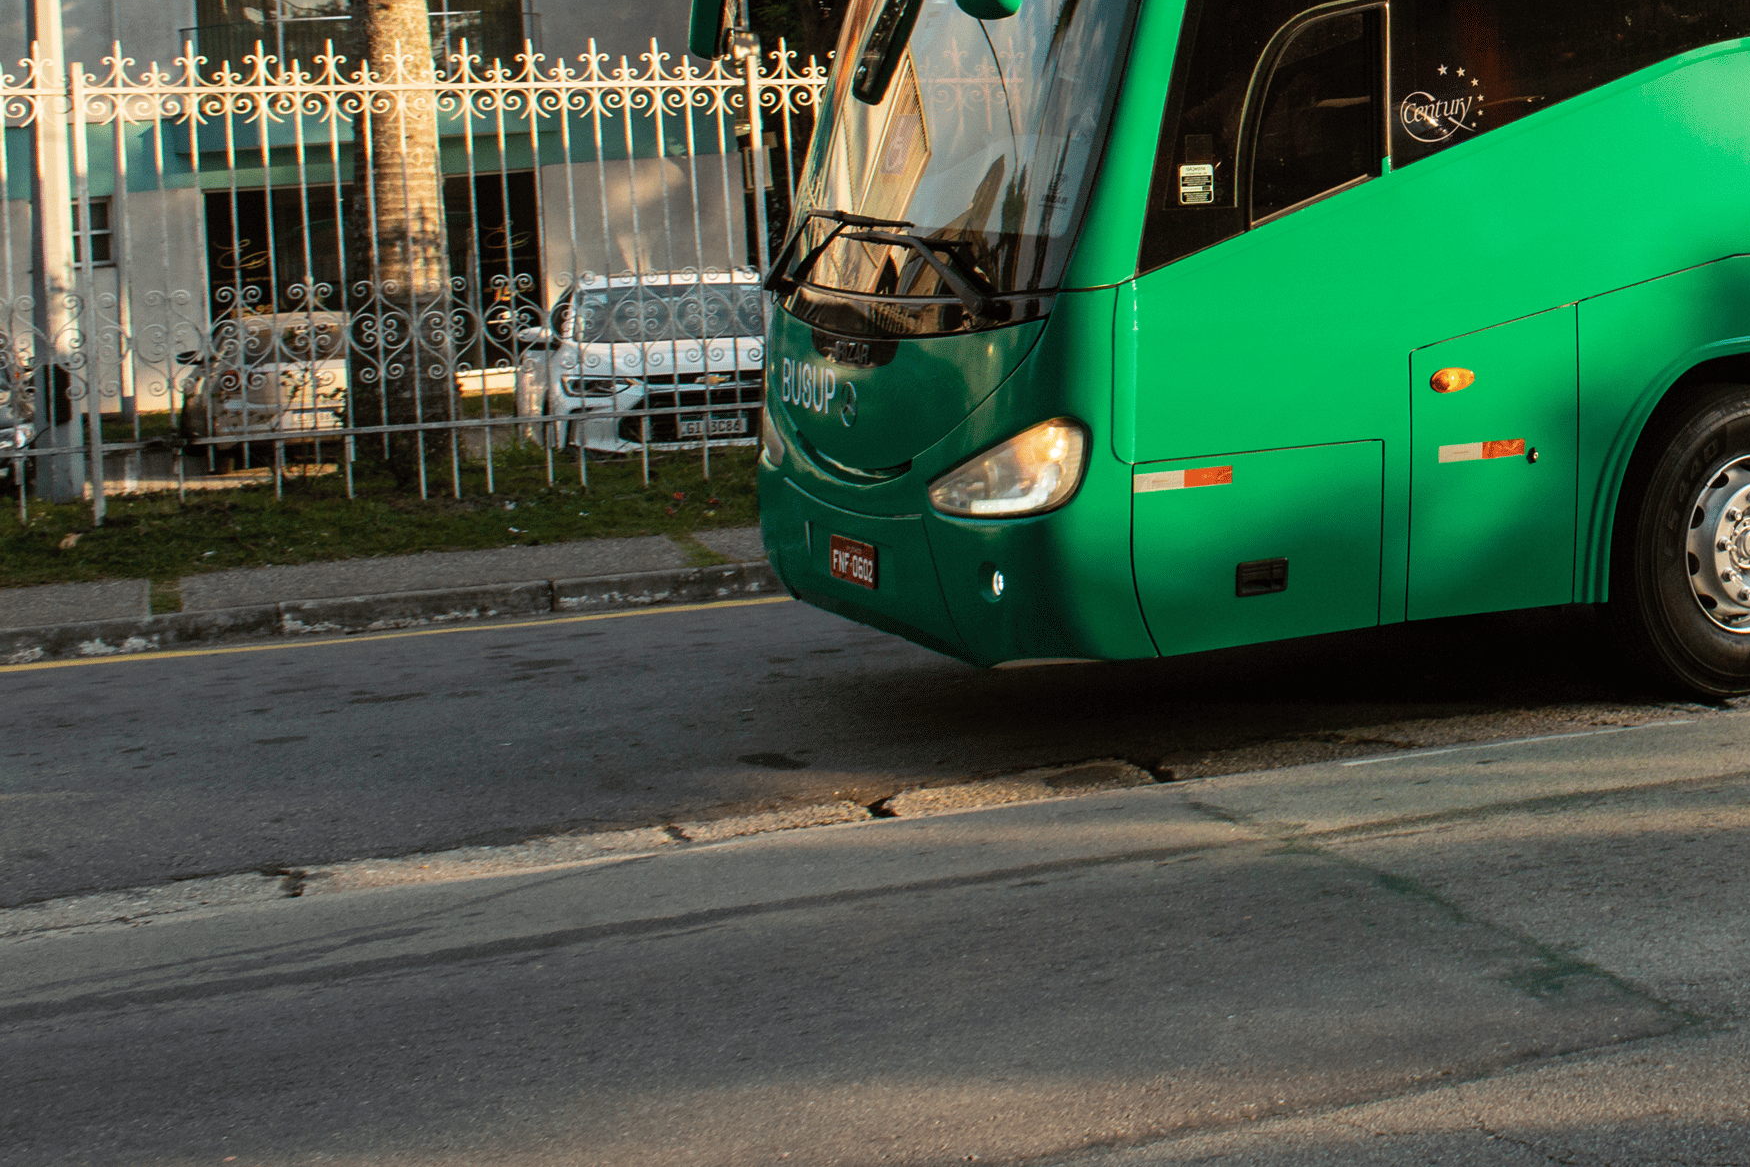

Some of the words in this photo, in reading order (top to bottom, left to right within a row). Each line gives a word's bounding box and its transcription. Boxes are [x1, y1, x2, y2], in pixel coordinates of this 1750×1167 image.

[1402, 95, 1473, 128] Century
[782, 357, 836, 414] BUSUP
[686, 419, 742, 434] GI3C86
